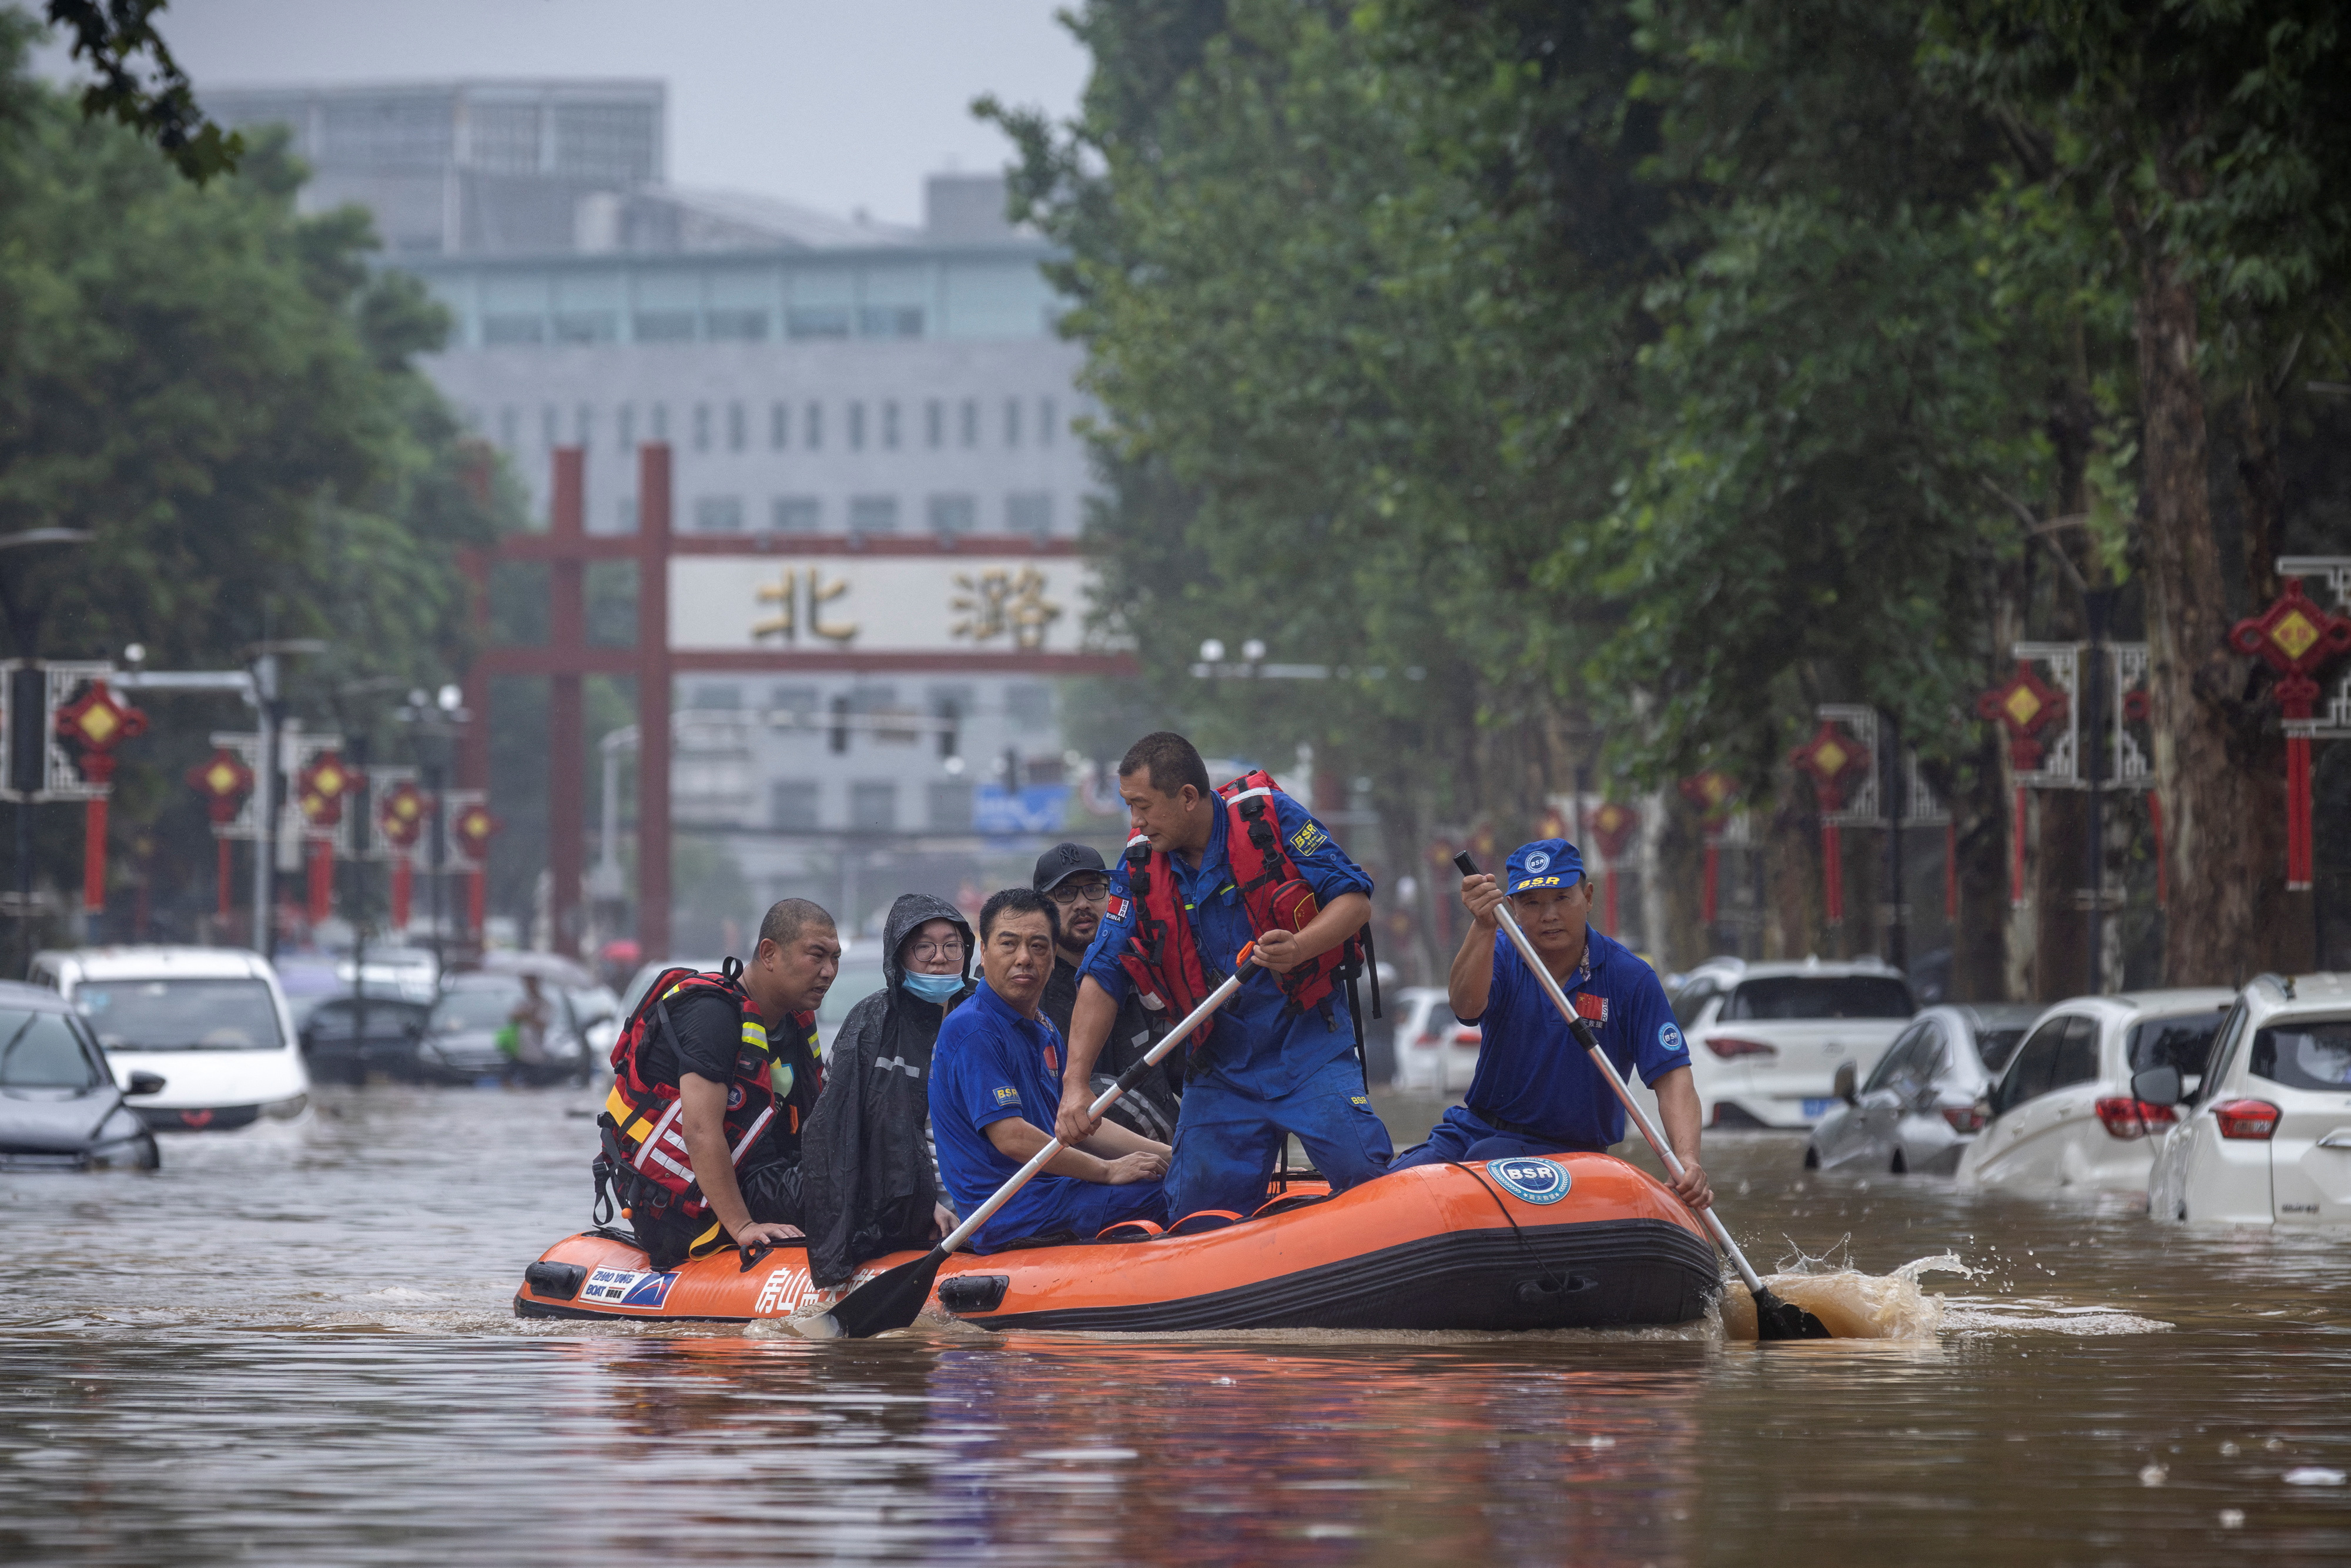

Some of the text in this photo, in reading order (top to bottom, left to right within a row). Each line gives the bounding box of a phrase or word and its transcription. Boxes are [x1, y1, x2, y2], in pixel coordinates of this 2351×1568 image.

[1295, 824, 1317, 848] BSR
[1518, 877, 1560, 890] BSR
[997, 1088, 1019, 1099] BSR
[1507, 1167, 1553, 1180] BSR
[592, 1271, 635, 1284] ZHAO YANG
[586, 1284, 607, 1296] BOAT
